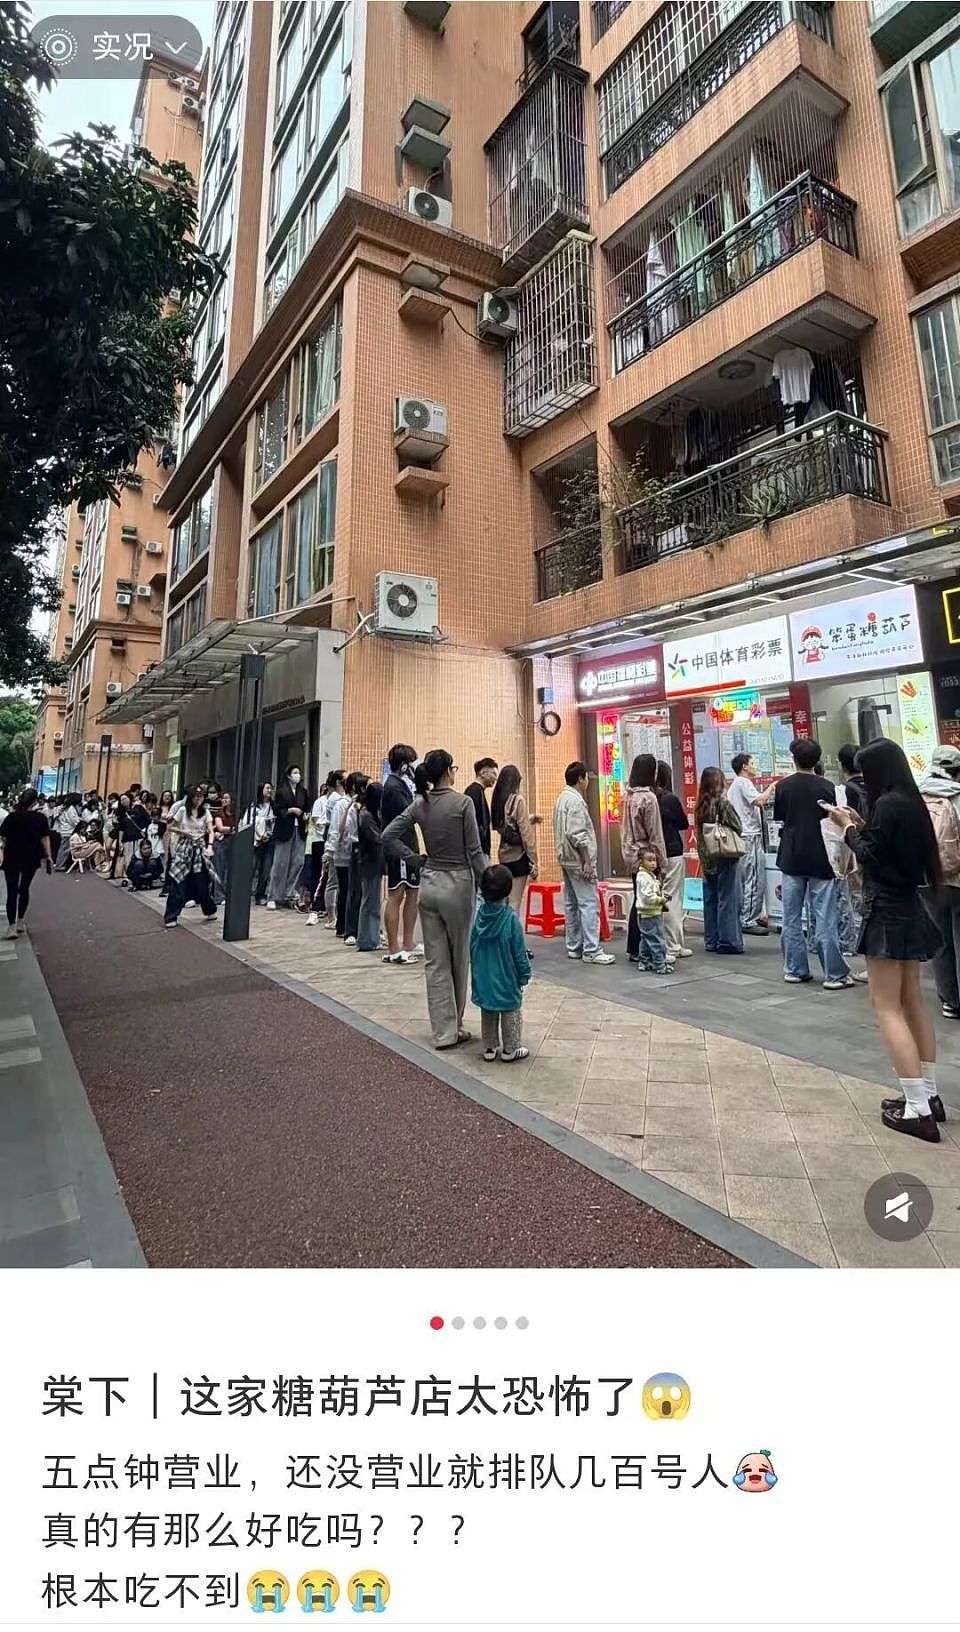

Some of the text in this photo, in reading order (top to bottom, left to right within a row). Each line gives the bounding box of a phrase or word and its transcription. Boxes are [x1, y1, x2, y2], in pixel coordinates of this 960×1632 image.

[829, 613, 911, 643] 笨蛋糖葫芦
[692, 638, 782, 671] 中国体育彩票
[681, 723, 695, 785] 公益体彩
